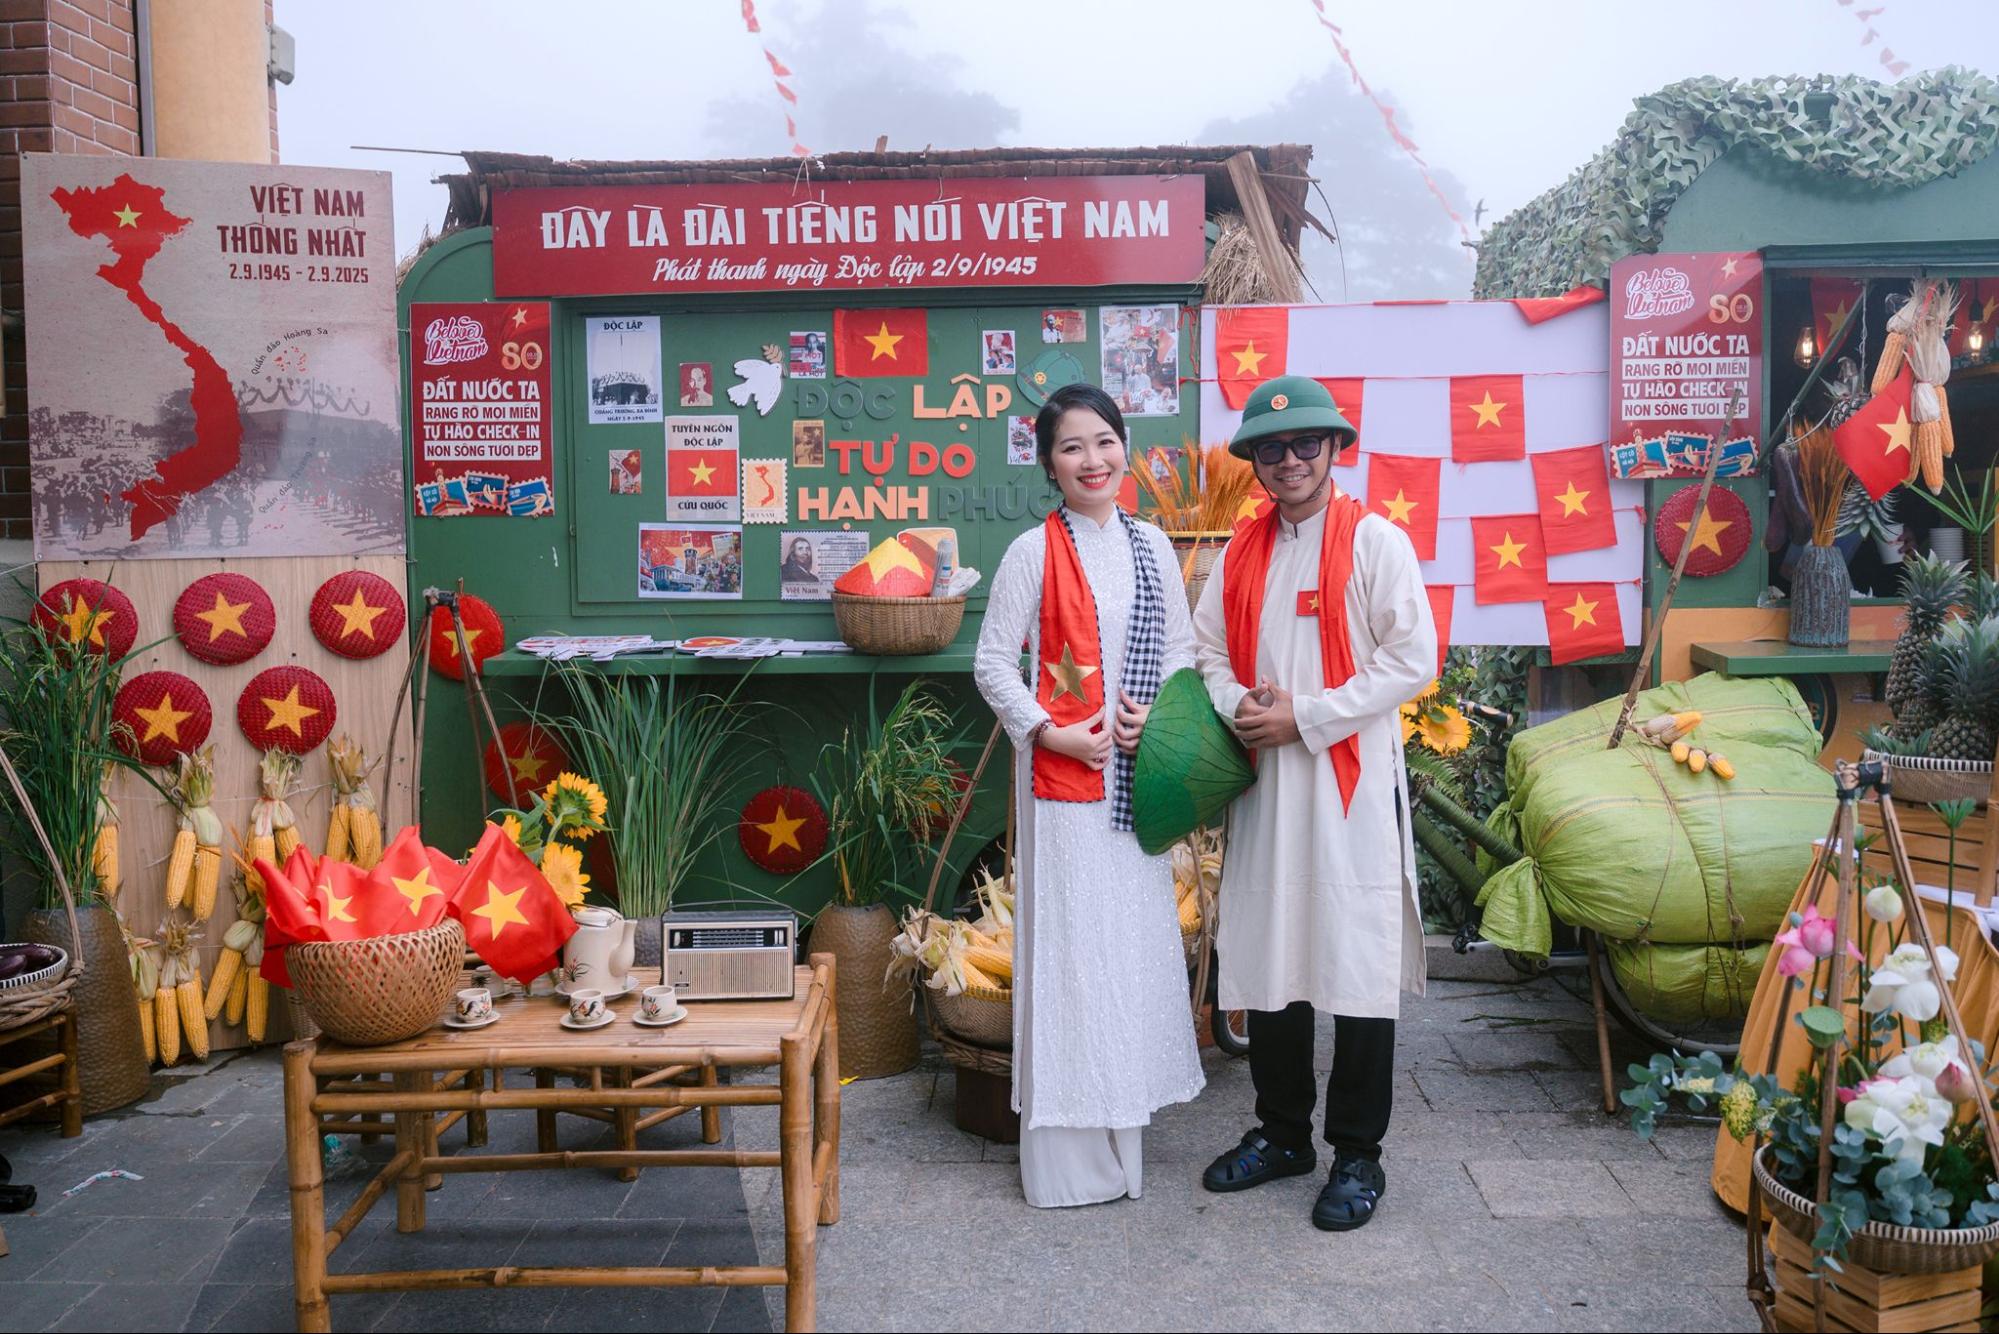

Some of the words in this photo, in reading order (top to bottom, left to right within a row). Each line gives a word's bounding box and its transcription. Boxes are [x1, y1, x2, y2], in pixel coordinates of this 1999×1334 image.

[250, 182, 304, 217] VIỆT
[314, 188, 365, 217] NAM
[539, 205, 612, 249] ĐÂY
[627, 203, 670, 248] LÀ
[682, 202, 746, 246] ĐÀI
[762, 190, 877, 245] TIẾNG
[894, 196, 962, 243] NÓI
[977, 196, 1066, 243] VIỆT
[1084, 199, 1169, 239] NAM
[216, 214, 298, 256] THỐNG
[308, 218, 367, 258] NHẤT
[229, 263, 291, 281] 2.9.1945
[308, 265, 369, 283] 2.9.2025
[652, 256, 702, 282] Phát
[707, 256, 767, 281] thanh
[774, 256, 828, 286] ngày
[834, 254, 882, 285] Độc
[889, 254, 925, 284] lập
[930, 252, 1038, 277] 2/9/1945
[603, 319, 625, 332] ĐỘC
[626, 321, 643, 333] LẬP
[1622, 330, 1659, 357] ĐẤT
[1665, 331, 1721, 356] NƯỚC
[1726, 334, 1750, 356] TA
[1624, 362, 1660, 378] RẠNG
[1686, 362, 1712, 377] MỌI
[423, 375, 457, 400] ĐẤT
[462, 377, 514, 400] NƯỚC
[518, 380, 541, 400] TA
[1622, 381, 1641, 400] TỰ
[1645, 379, 1676, 398] HÀO
[793, 378, 897, 432] ĐỘC
[912, 373, 1012, 432] LẬP
[1624, 403, 1651, 417] NON
[1654, 401, 1688, 416] SÔNG
[425, 406, 459, 421] RẠNG
[482, 406, 506, 421] MỌI
[423, 423, 442, 441] TỰ
[444, 422, 474, 440] HÀO
[477, 424, 540, 440] CHECK-IN
[672, 423, 701, 433] TUYÊN
[703, 423, 733, 433] NGÔN
[427, 444, 452, 457] NON
[454, 442, 485, 457] SÔNG
[684, 436, 704, 447] ĐỘC
[707, 437, 723, 447] LẬP
[828, 432, 900, 487] TỰ
[908, 441, 976, 479] DO
[797, 485, 929, 531] HẠNH
